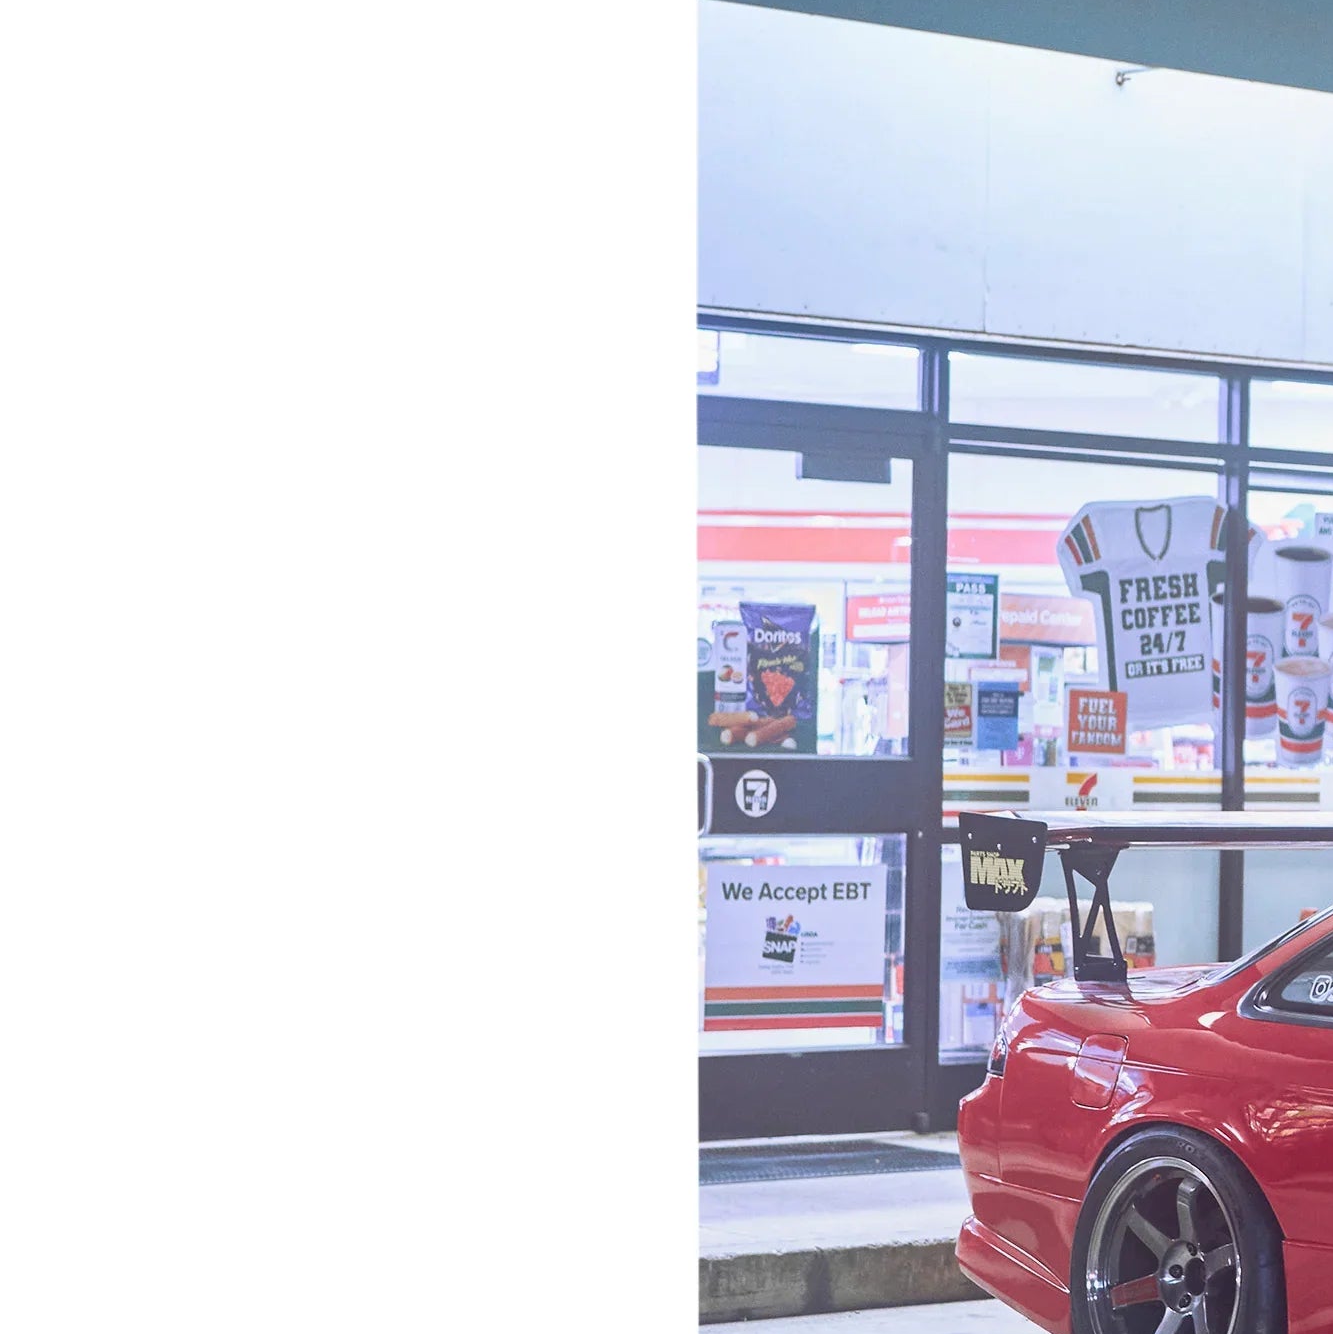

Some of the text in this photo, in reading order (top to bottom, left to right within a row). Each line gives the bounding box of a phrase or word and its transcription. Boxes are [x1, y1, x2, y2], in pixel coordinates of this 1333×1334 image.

[955, 582, 987, 595] PASS
[1119, 573, 1200, 604] FRESH
[1000, 610, 1038, 626] repaid
[1121, 603, 1202, 630] COFFEE
[754, 628, 802, 645] Doritos
[1140, 630, 1187, 655] 24/7
[1127, 662, 1143, 677] OR
[1172, 655, 1204, 673] FREE
[1078, 696, 1117, 715] FUEL
[1077, 714, 1118, 731] YOUR
[970, 856, 1025, 885] MAX
[722, 882, 872, 904] We Accept EBT
[762, 940, 796, 955] SNAP
